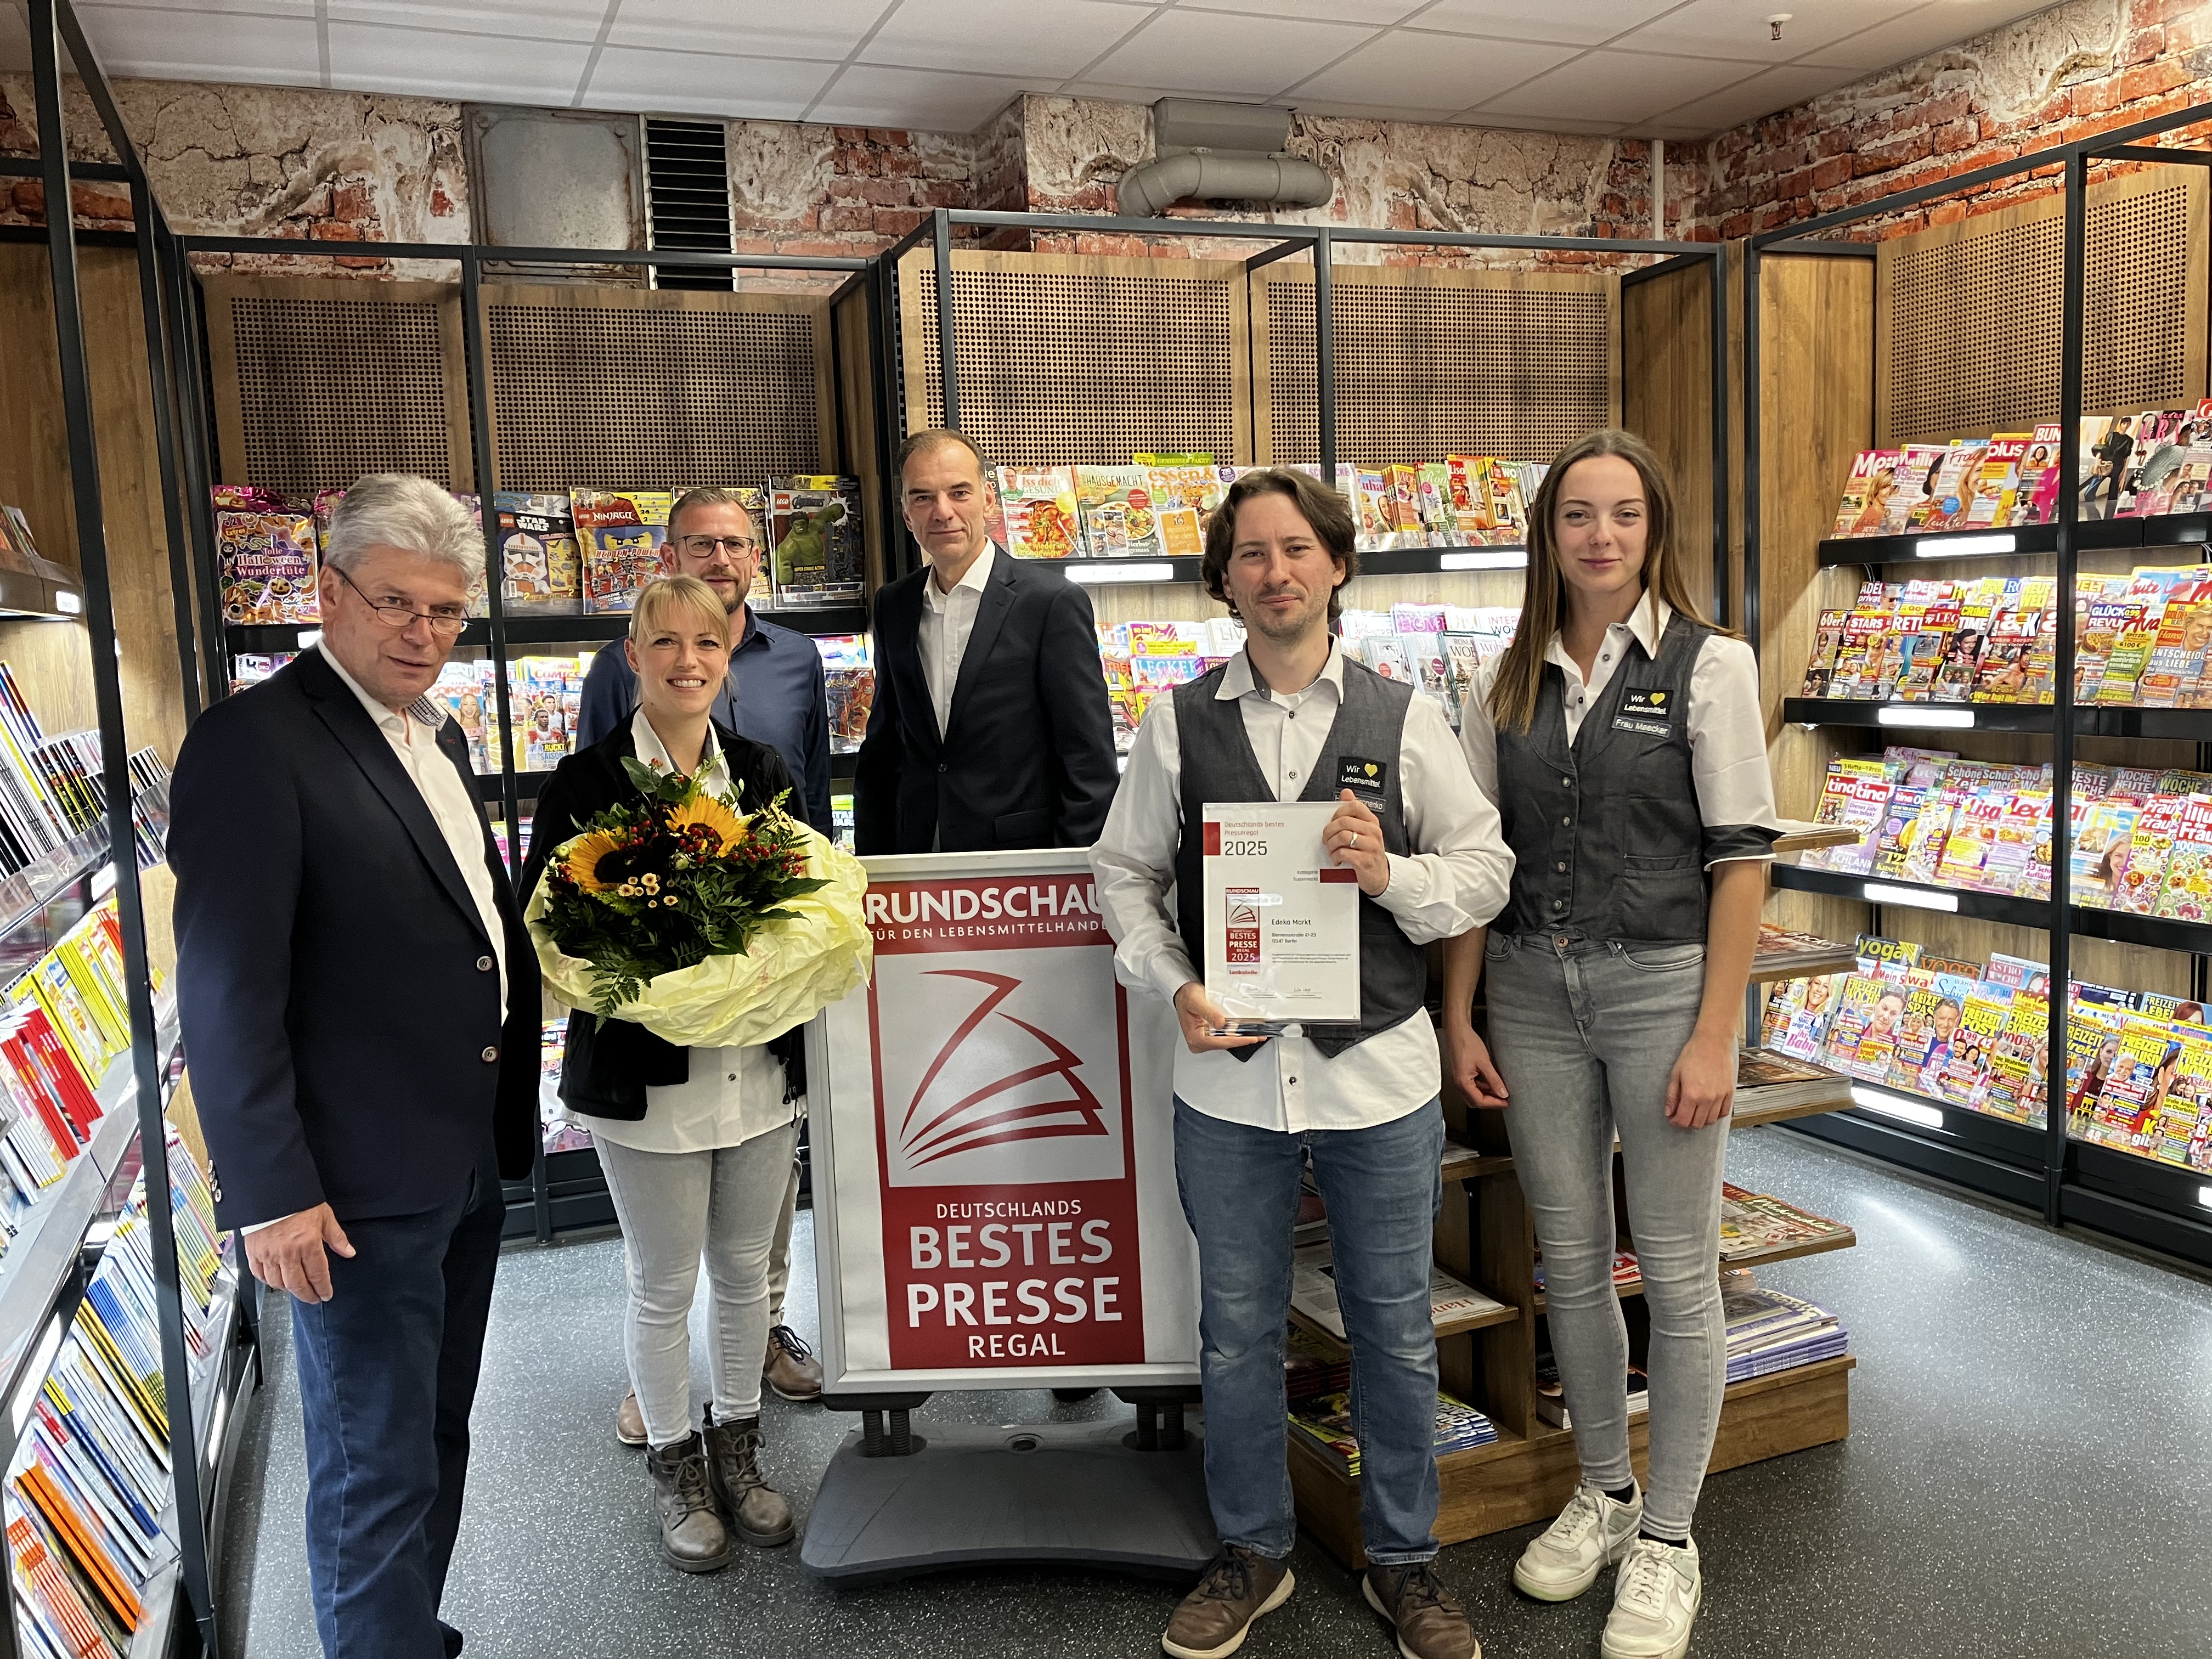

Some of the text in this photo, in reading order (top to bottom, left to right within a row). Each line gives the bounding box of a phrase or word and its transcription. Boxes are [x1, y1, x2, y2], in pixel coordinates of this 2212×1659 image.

[1086, 475, 1143, 486] HAUSGEMACHT
[516, 516, 549, 526] STAR
[517, 522, 549, 531] WARS
[236, 566, 306, 577] Wundertüte
[1961, 606, 1991, 617] CRIME
[1820, 612, 1846, 627] 60er!
[1850, 617, 1883, 629] STARS
[1958, 617, 1988, 630] TIME
[2158, 629, 2183, 639] Hansi
[2165, 659, 2191, 669] LIEBE
[1616, 719, 1633, 729] Frau
[1346, 765, 1361, 773] Wir
[1948, 766, 1982, 780] Schöne
[2117, 770, 2154, 783] WOCHE
[2160, 777, 2202, 793] WOCHE
[1856, 784, 1887, 802] tina
[1966, 799, 2002, 820] Lisa
[2143, 799, 2175, 815] Frau
[2138, 815, 2171, 830] Frau
[1224, 840, 1267, 856] 2025
[2176, 840, 2194, 851] 100
[903, 927, 932, 939] DEN
[1857, 938, 1904, 961] yoga
[1231, 953, 1255, 962] 2025
[1990, 962, 2022, 976] ASTRO
[1962, 1006, 2002, 1026] FREIZEIT
[1959, 1017, 2000, 1037] POST
[2137, 1026, 2164, 1037] Rouladen
[1785, 1033, 1818, 1054] Baby
[1980, 1038, 1993, 1047] 42
[2121, 1035, 2168, 1057] FREIZEIT
[936, 1200, 1082, 1219] DEUTSCHLANDS
[911, 1219, 1113, 1269] BESTES
[907, 1276, 1122, 1328] PRESSE
[968, 1333, 1066, 1359] REGAL
